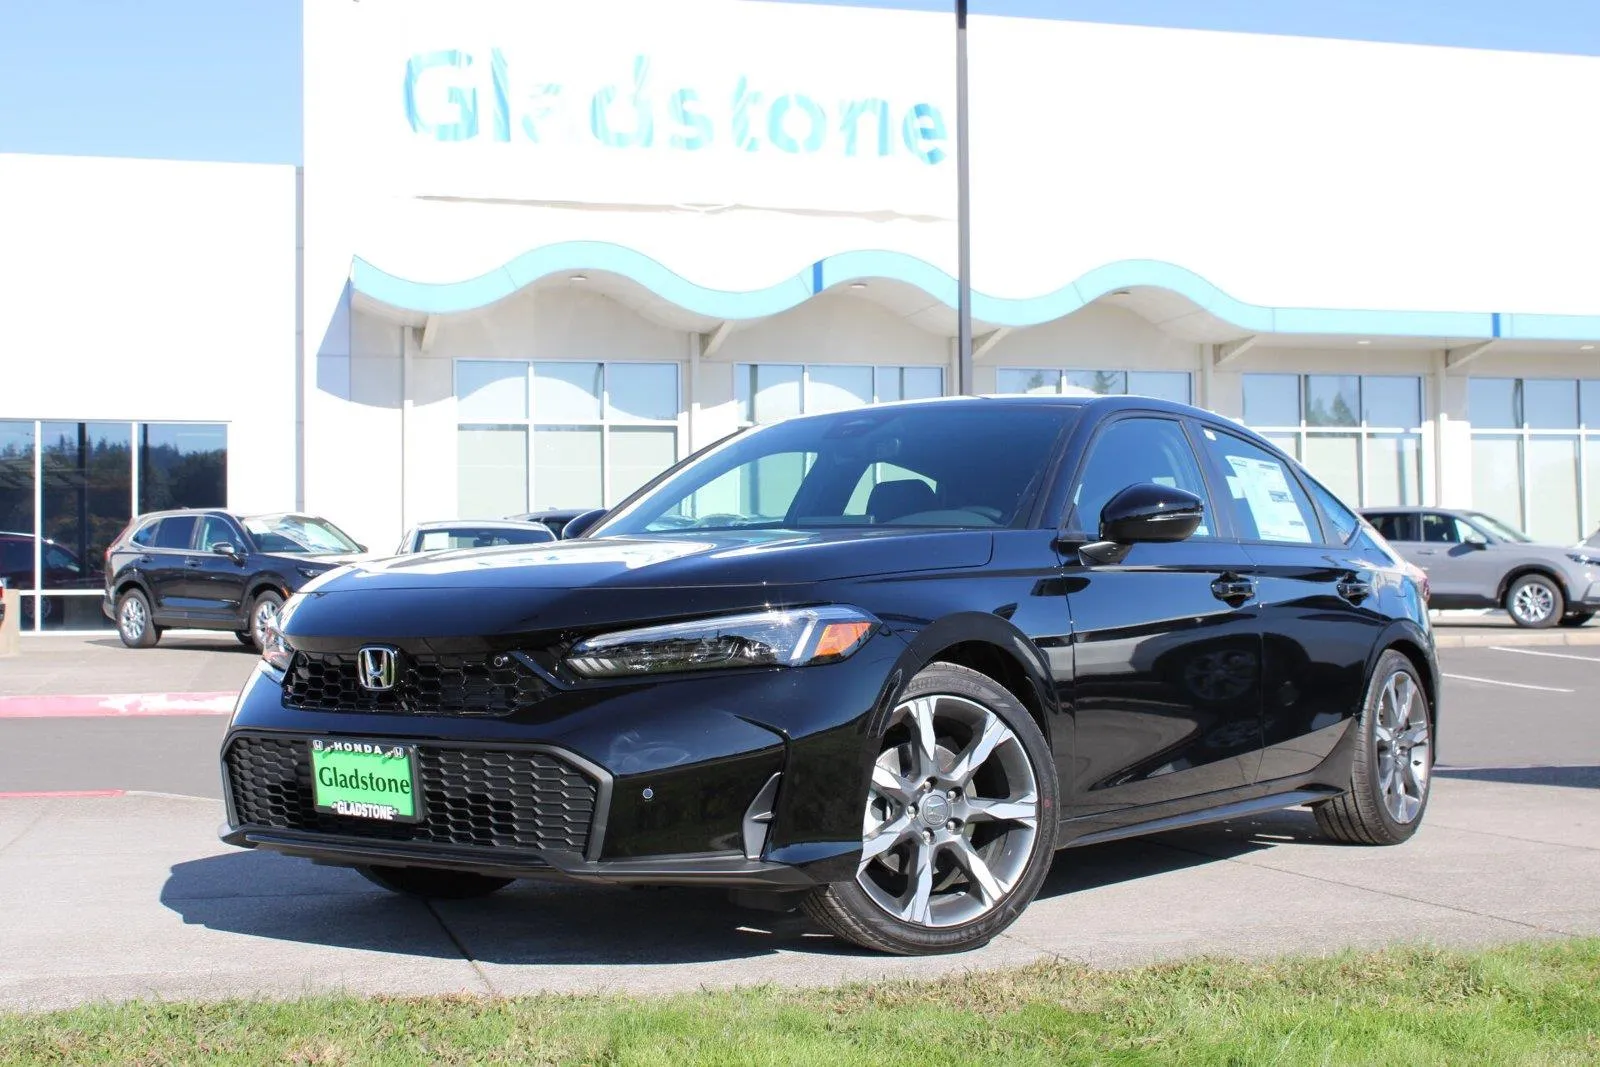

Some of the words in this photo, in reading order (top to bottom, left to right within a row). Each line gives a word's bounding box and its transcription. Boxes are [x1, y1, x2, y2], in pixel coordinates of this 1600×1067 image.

[333, 741, 382, 755] HONDA
[319, 766, 410, 794] Gladstone
[336, 800, 393, 820] GLADSTONE
